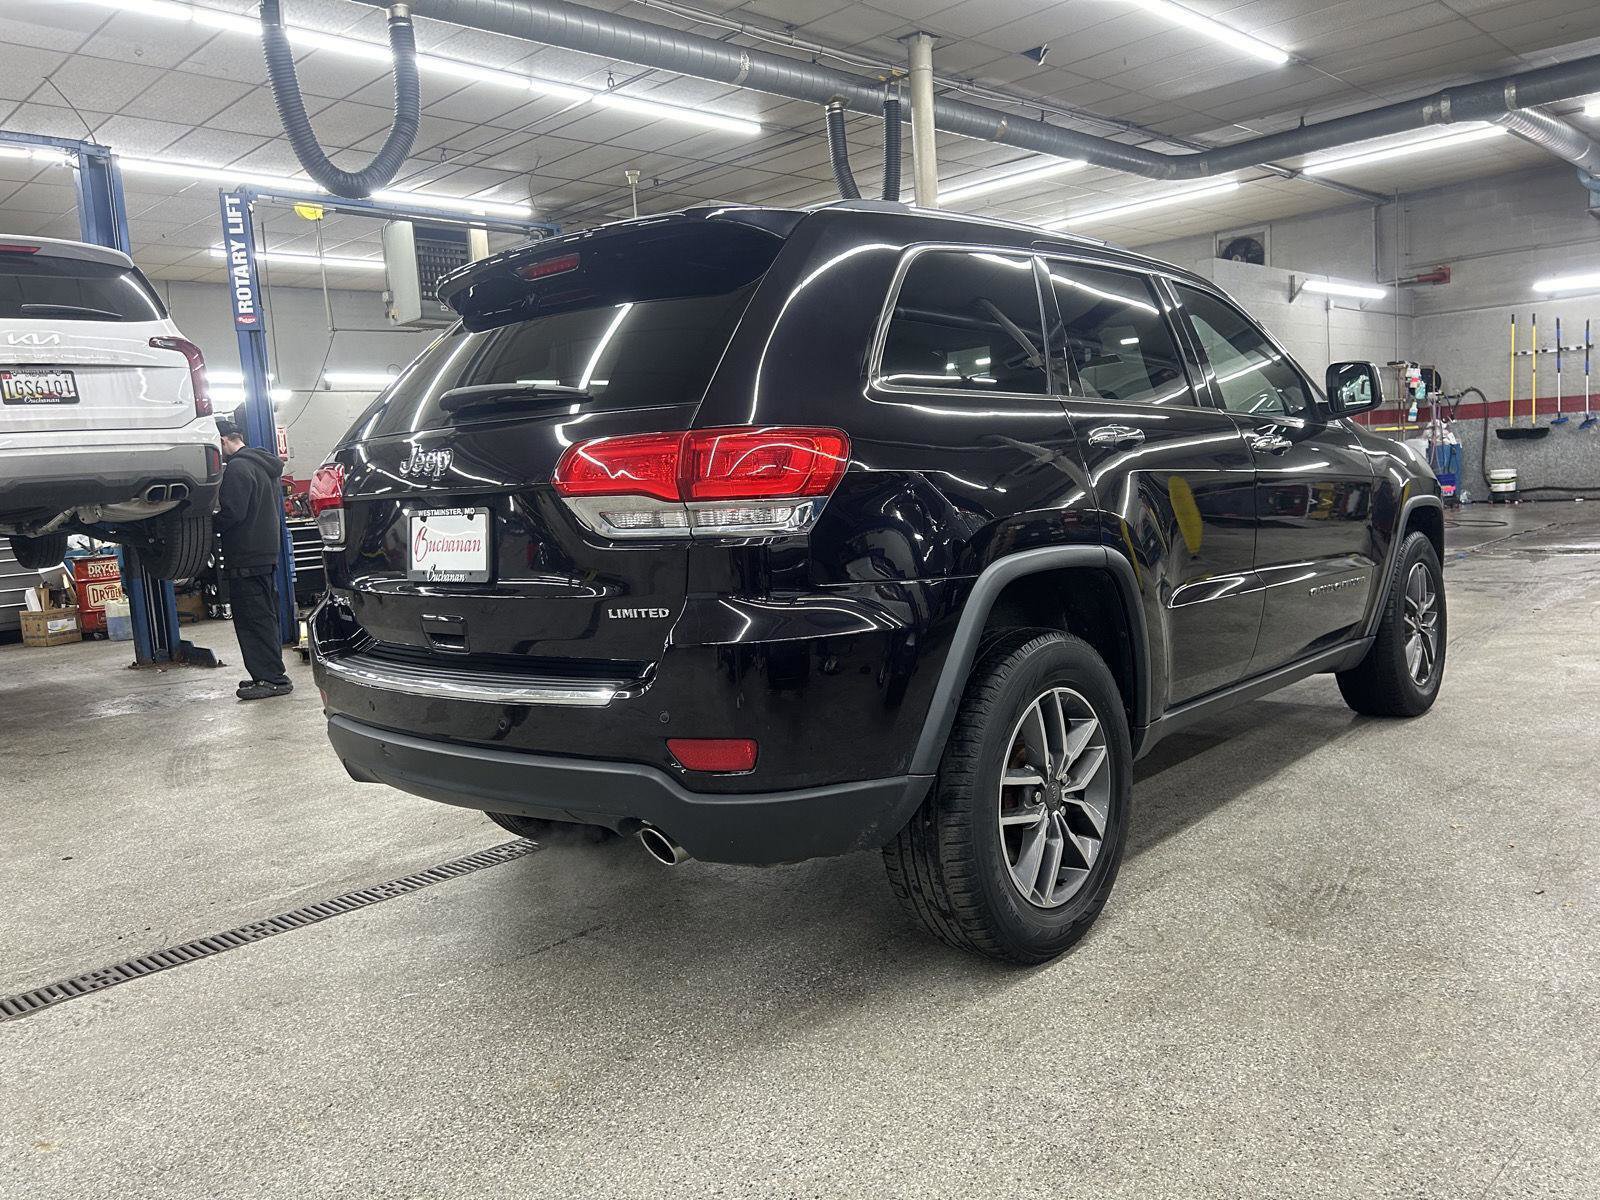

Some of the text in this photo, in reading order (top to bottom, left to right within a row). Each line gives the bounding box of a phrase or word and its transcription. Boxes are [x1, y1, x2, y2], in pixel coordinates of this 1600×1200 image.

[225, 195, 253, 313] ROTARY LIFT
[400, 443, 454, 481] Jeep
[464, 507, 475, 516] MD
[414, 526, 482, 562] Buchanan
[426, 564, 466, 582] Buchanan
[607, 608, 670, 619] LIMITED
